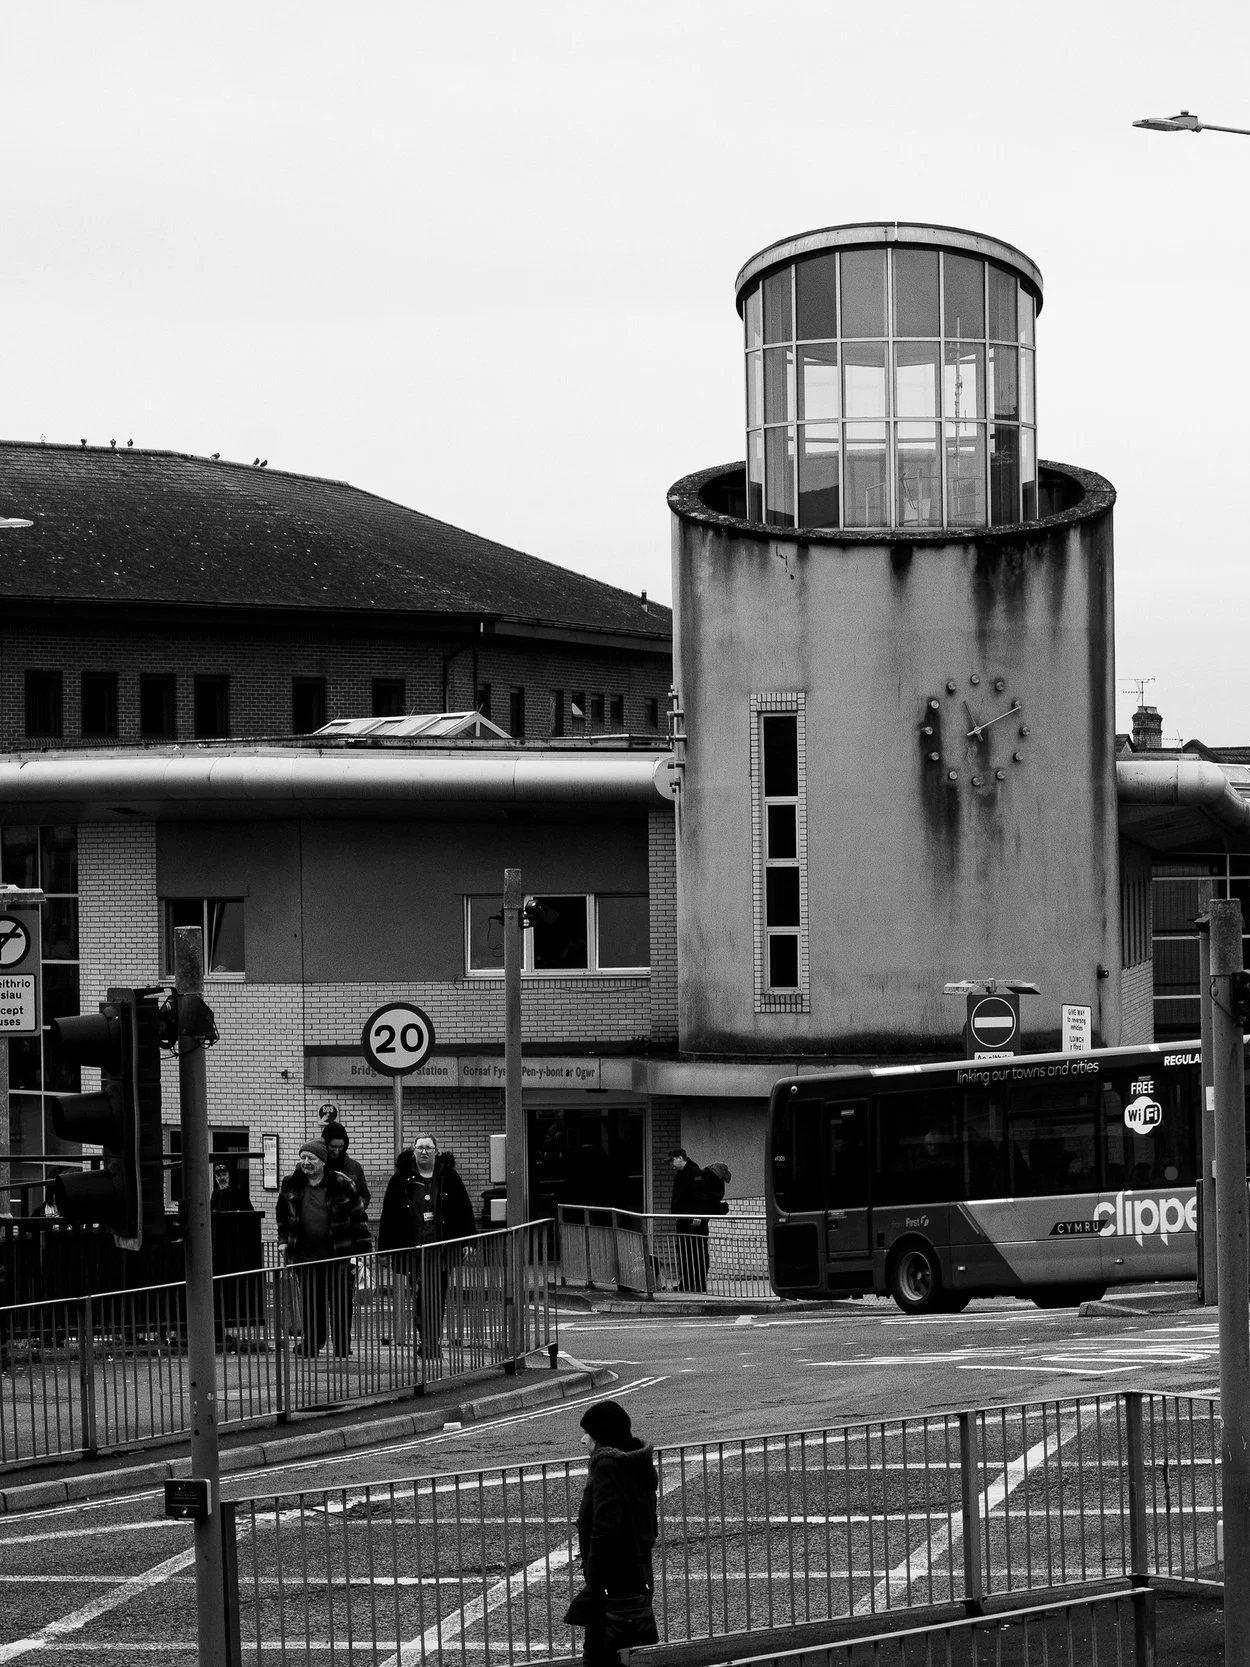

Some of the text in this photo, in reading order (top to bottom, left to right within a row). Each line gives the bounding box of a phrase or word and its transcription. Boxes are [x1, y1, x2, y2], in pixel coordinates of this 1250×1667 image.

[374, 1022, 425, 1054] 20
[1164, 1053, 1202, 1067] REGULA
[463, 1065, 596, 1081] Gorsaf Fys Pen-y-bont ar Ogwr
[956, 1059, 1100, 1086] linking our towns and cities
[1130, 1081, 1155, 1095] FREE
[905, 1217, 920, 1227] First
[1057, 1189, 1198, 1248] CYMRU clippe
